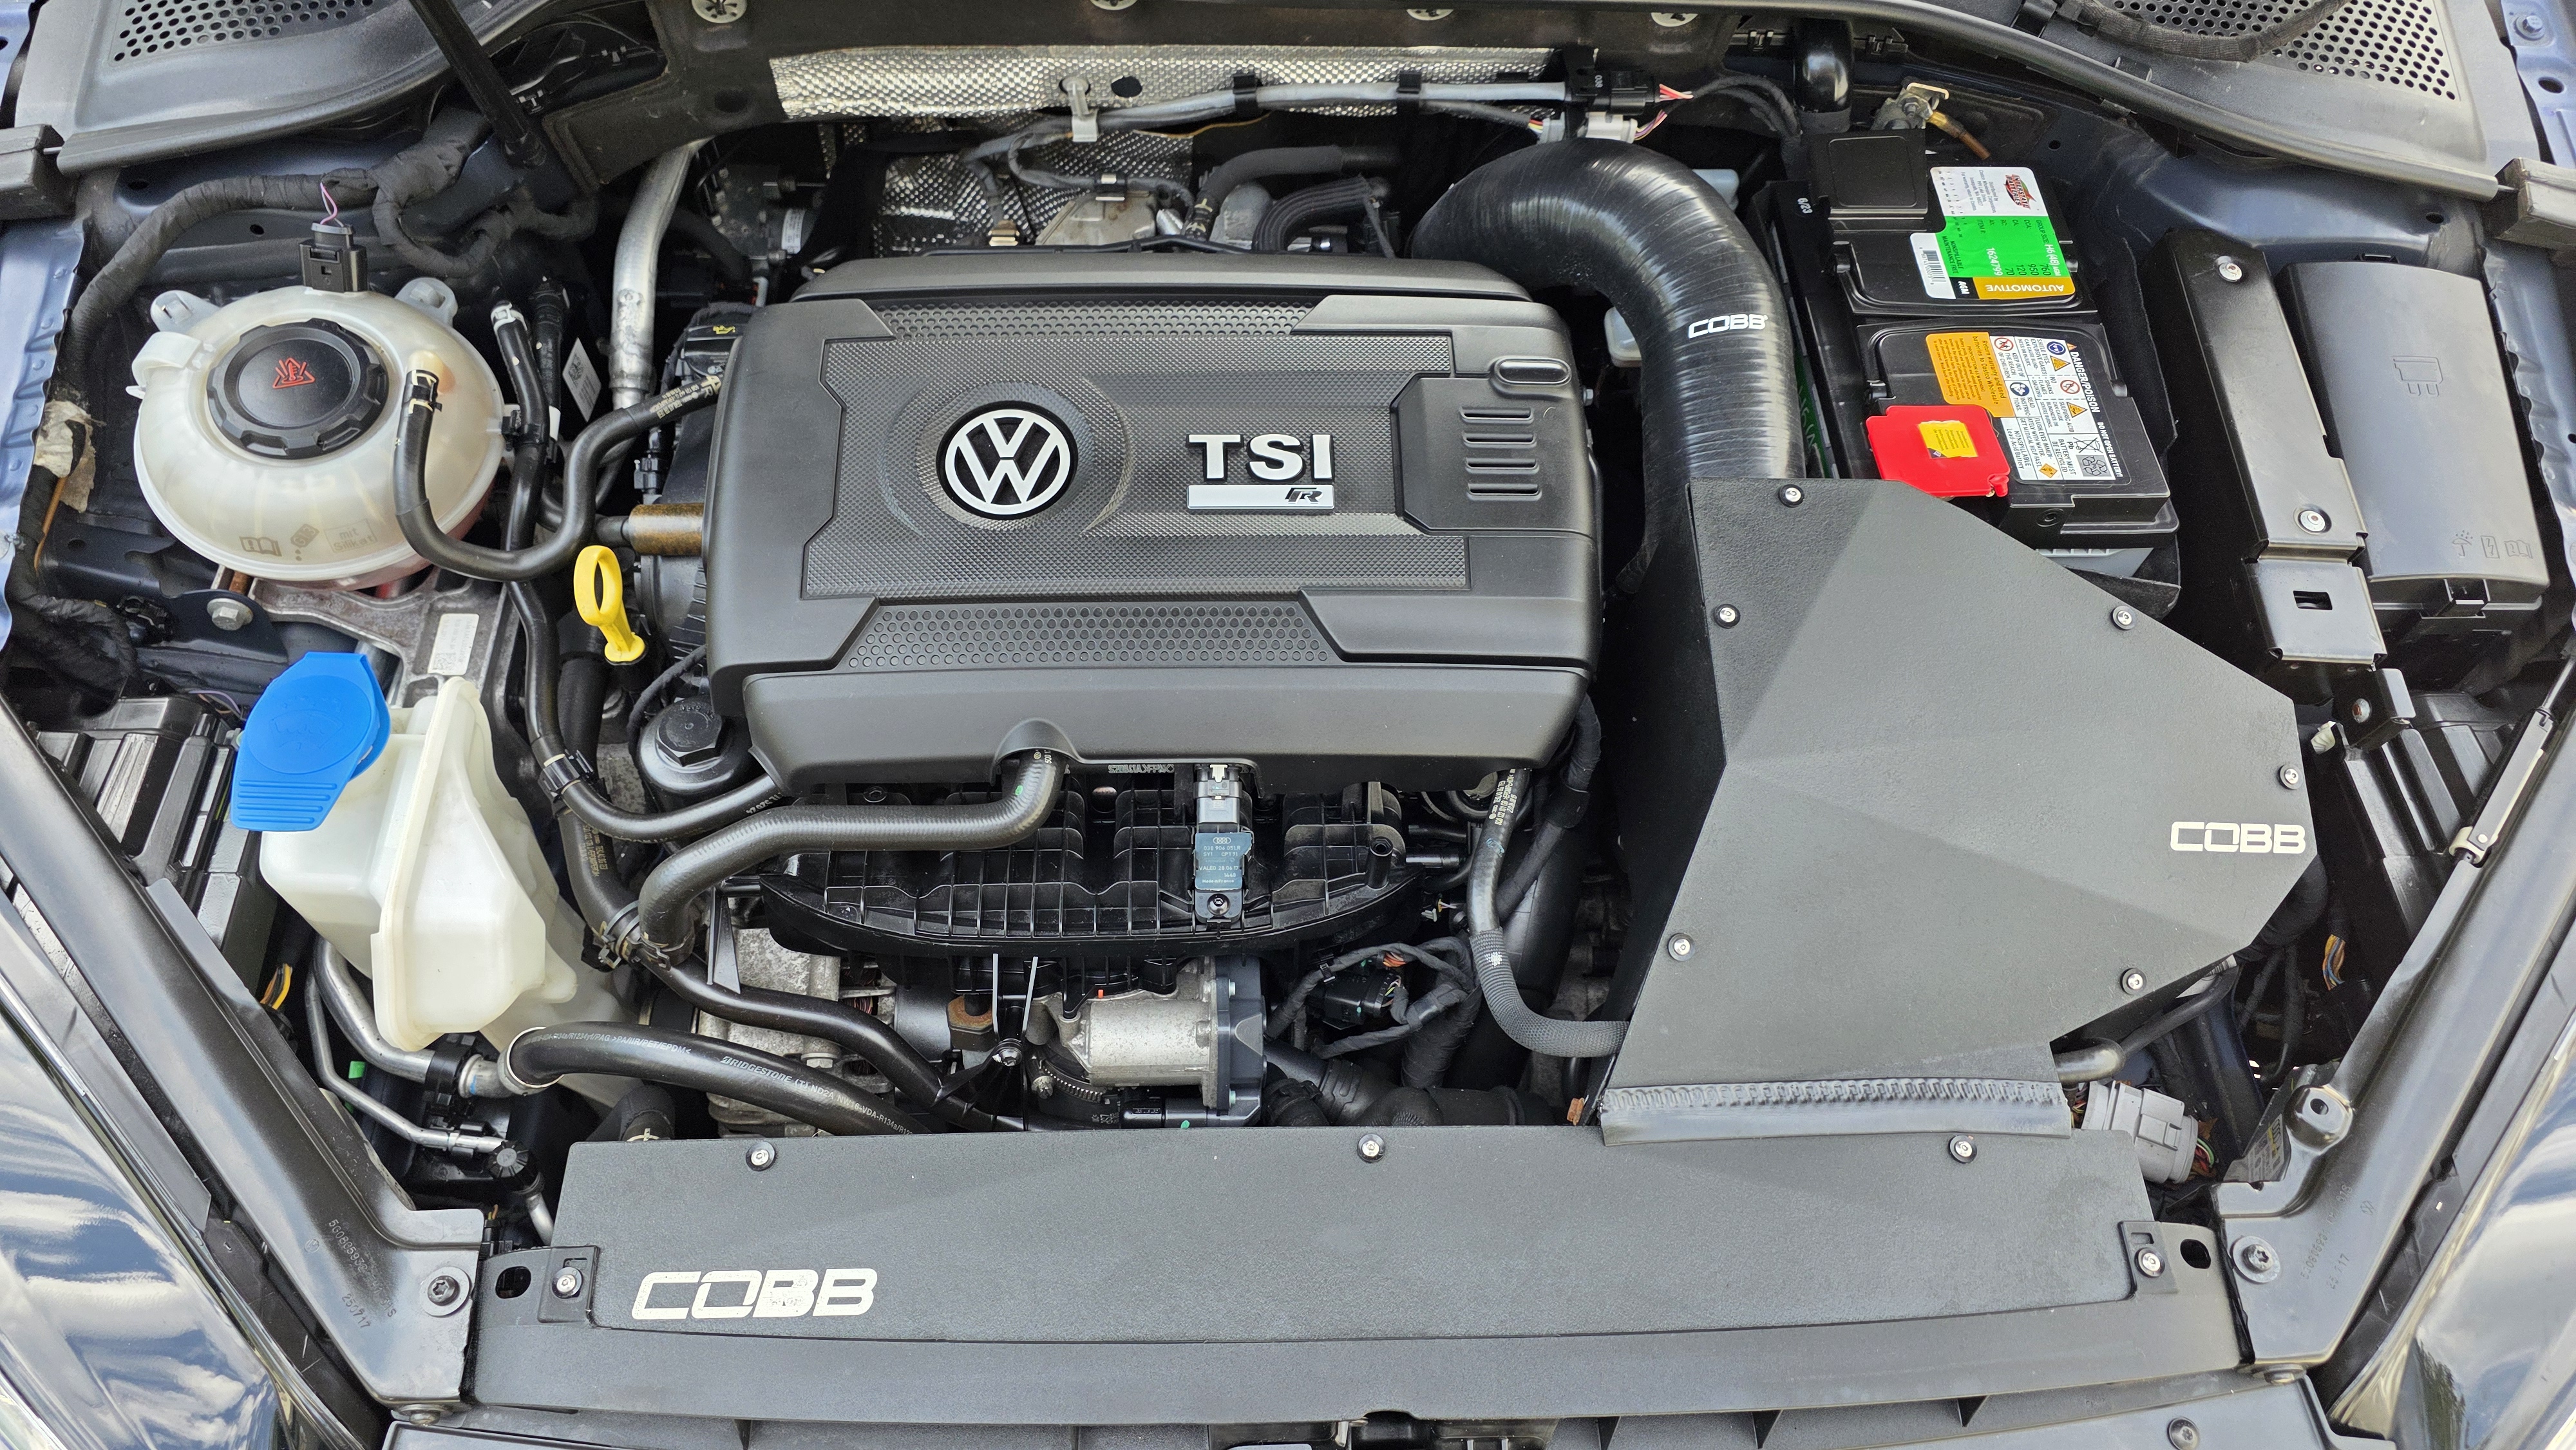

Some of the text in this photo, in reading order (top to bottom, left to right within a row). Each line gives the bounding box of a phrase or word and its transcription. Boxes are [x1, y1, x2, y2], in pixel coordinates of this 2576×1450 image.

[2005, 176, 2022, 206] BATTERIES
[2012, 175, 2030, 209] INTERSTATE
[1942, 236, 1955, 263] MAINTENANCE
[1950, 265, 1959, 274] FREE
[1950, 241, 1964, 269] NONSPILLABLE
[1976, 220, 1985, 229] ITEM
[1986, 247, 2003, 276] 1624799
[2036, 220, 2061, 276] GROUP SIZE: H6 (48) AGM
[2016, 265, 2027, 276] 120
[2027, 264, 2039, 276] 950
[2040, 264, 2051, 276] 760
[1958, 281, 1969, 294] AGM
[1689, 314, 1766, 339] COBB
[2026, 347, 2034, 357] CAUSE
[2031, 339, 2047, 375] EXPLOSIVE GASES
[2037, 339, 2050, 364] SHIELD EYES.
[1967, 346, 1979, 370] PROPOSITION
[1976, 375, 1985, 391] WARNING
[1973, 336, 1983, 356] batteries
[1982, 363, 1990, 379] Costco
[1987, 381, 1999, 404] Wholesale
[1982, 341, 1991, 355] Return
[1987, 357, 1998, 376] warranty
[1998, 387, 2007, 399] used
[2000, 359, 2011, 379] CHILDREN.
[2008, 361, 2017, 375] REACH
[2031, 380, 2042, 397] SMOKING
[2038, 379, 2047, 395] FLAMES
[2044, 380, 2054, 394] SPARKS
[2070, 352, 2100, 412] DANGER/POISON
[2013, 398, 2022, 411] TIONS.
[2020, 398, 2031, 417] INSTRUC-
[2046, 402, 2056, 420] BLINDNESS
[2060, 402, 2070, 422] SULFURIC
[2023, 427, 2033, 444] MEDICAL
[2034, 417, 2043, 431] FLUSH
[2043, 443, 2053, 459] IMMEDI-
[2100, 430, 2109, 440] NOT
[2104, 440, 2114, 453] OPEN
[1189, 434, 1332, 480] TSI
[2007, 428, 2024, 469] Lead-Acid Battery
[2014, 431, 2031, 466] NONSPILLABLE
[2036, 442, 2045, 457] WATER.
[2054, 448, 2068, 472] RECYCLED
[2058, 439, 2076, 475] BATTERY MUST
[945, 410, 1070, 514] VW
[2108, 455, 2123, 477] BATTERY!
[1285, 487, 1323, 505] R
[294, 527, 316, 545] G13
[334, 536, 374, 551] Silikat
[339, 528, 359, 540] mit
[2170, 822, 2306, 854] COBB
[720, 1055, 792, 1083] BRIDGESTONE
[810, 1085, 835, 1100] ND2A
[631, 1268, 878, 1320] COBB
